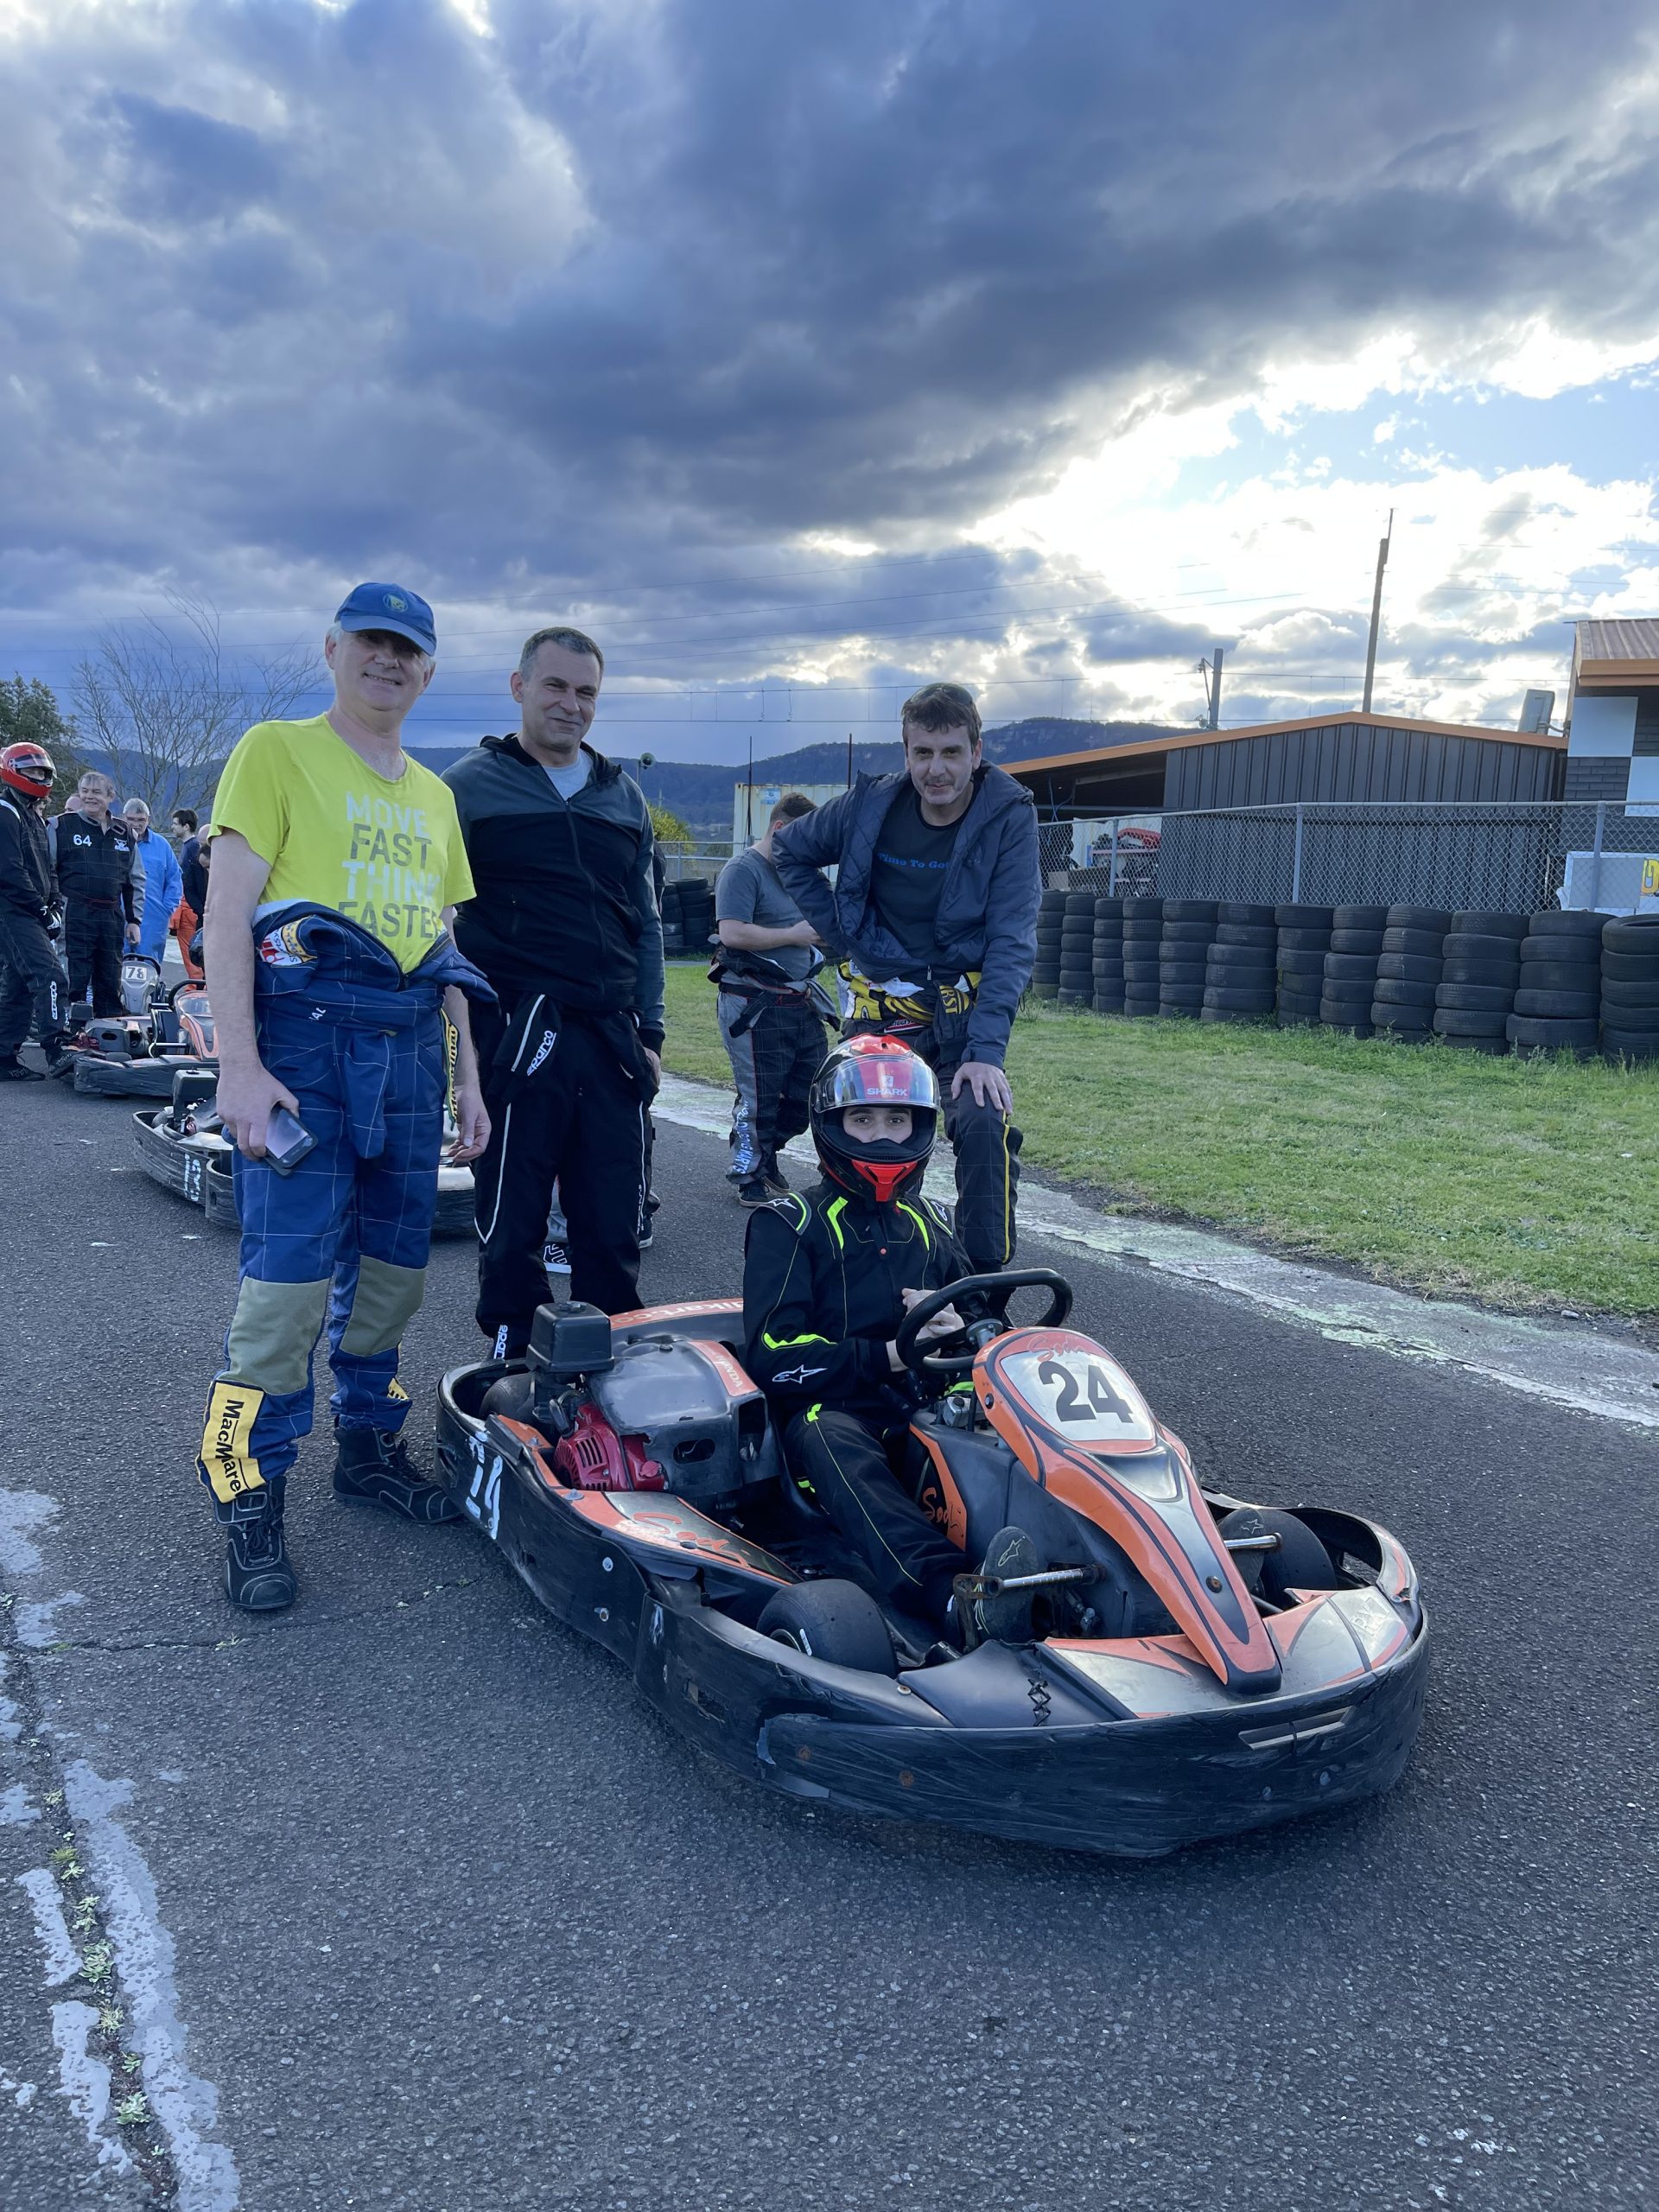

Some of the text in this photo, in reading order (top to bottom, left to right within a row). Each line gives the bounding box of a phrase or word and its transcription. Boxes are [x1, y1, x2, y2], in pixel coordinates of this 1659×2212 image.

[346, 791, 430, 838] MOVE
[73, 834, 92, 847] 64
[350, 823, 432, 869] FAST
[910, 859, 925, 868] To
[342, 861, 441, 907] THINK
[127, 967, 145, 980] 78
[867, 1087, 908, 1096] SHARK
[1038, 1361, 1134, 1423] 24
[214, 1399, 245, 1492] MacMare
